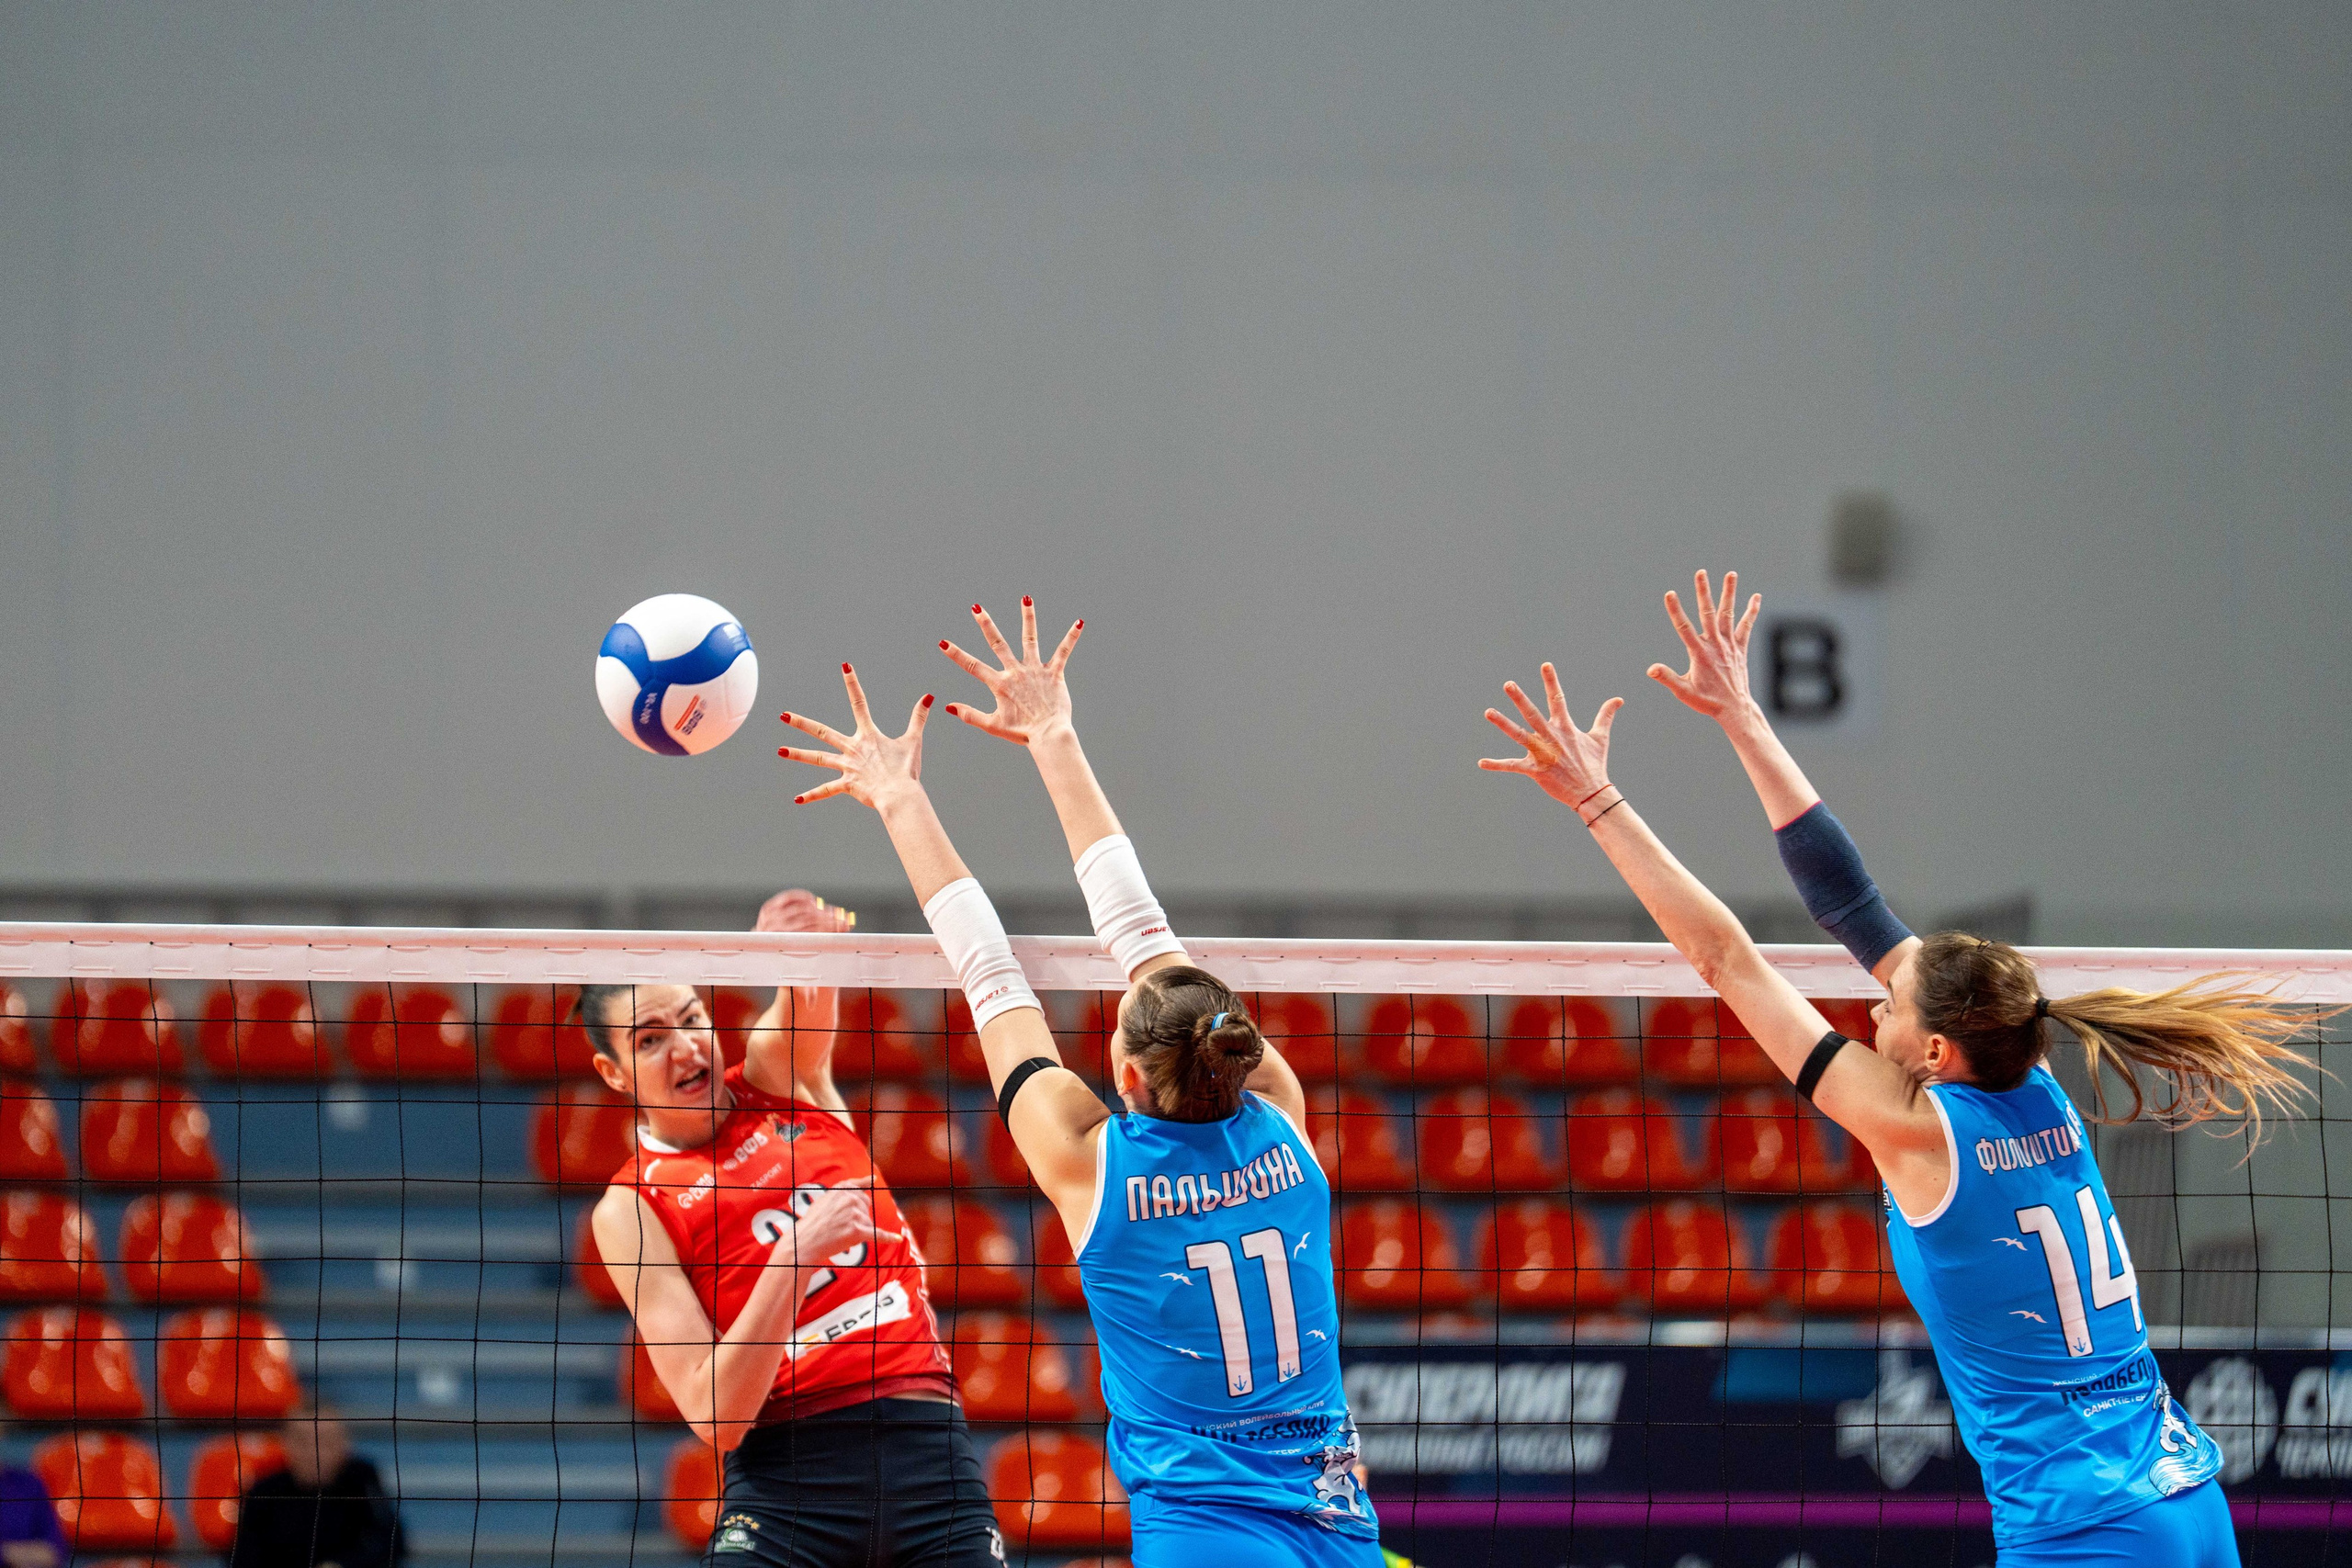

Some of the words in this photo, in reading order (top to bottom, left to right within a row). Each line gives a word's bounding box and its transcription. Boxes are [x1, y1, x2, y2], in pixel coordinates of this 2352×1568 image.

[1125, 1142, 1306, 1222] ПАЛЬШИНА
[1185, 1227, 1302, 1397] 11
[2015, 1184, 2143, 1358] 14
